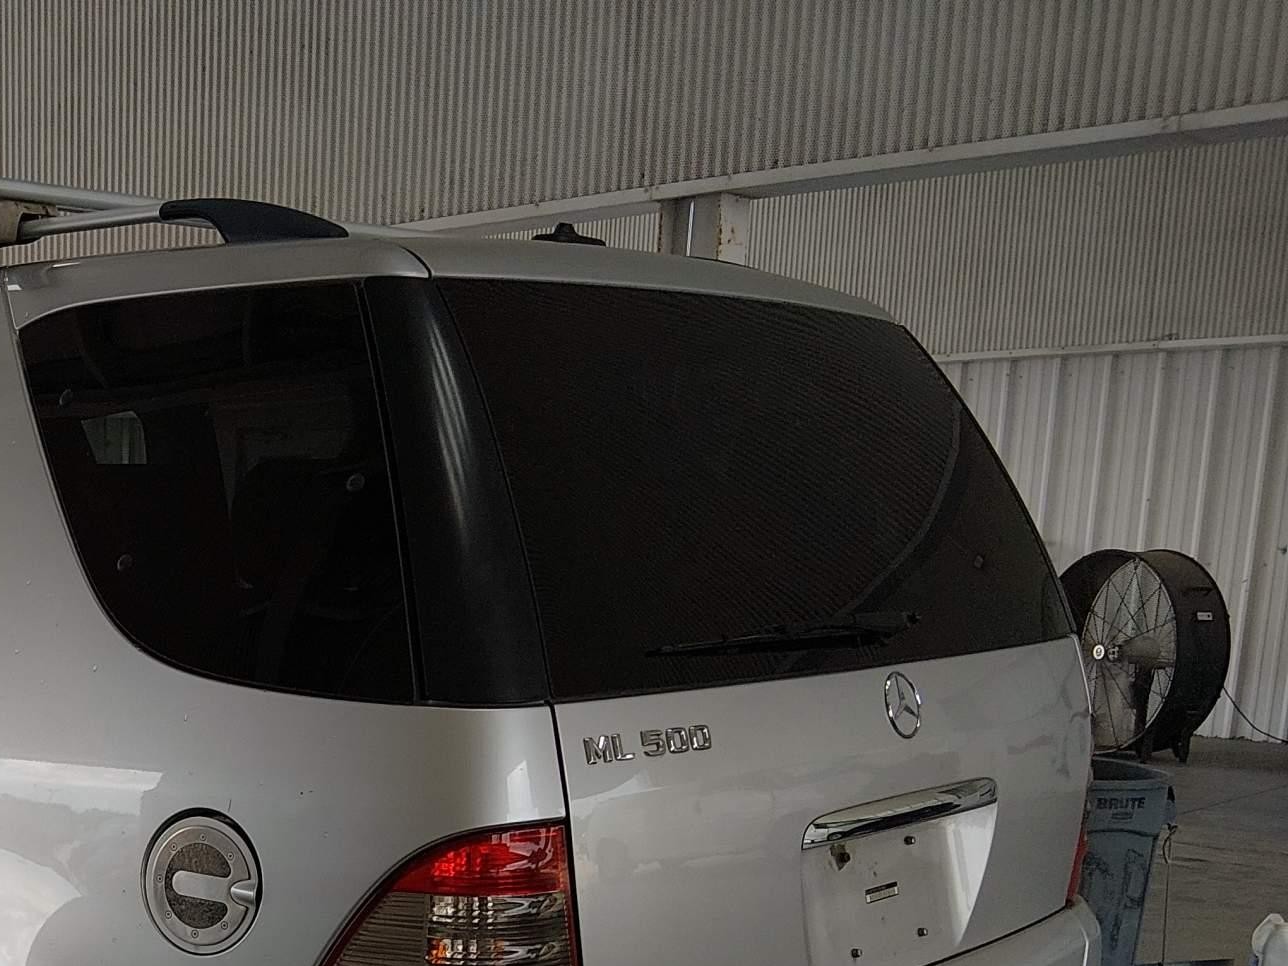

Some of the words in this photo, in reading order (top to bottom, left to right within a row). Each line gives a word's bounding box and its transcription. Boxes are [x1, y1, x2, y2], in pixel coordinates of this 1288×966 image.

[583, 733, 635, 765] ML
[640, 724, 712, 757] 500
[1095, 796, 1146, 810] BRUTE
